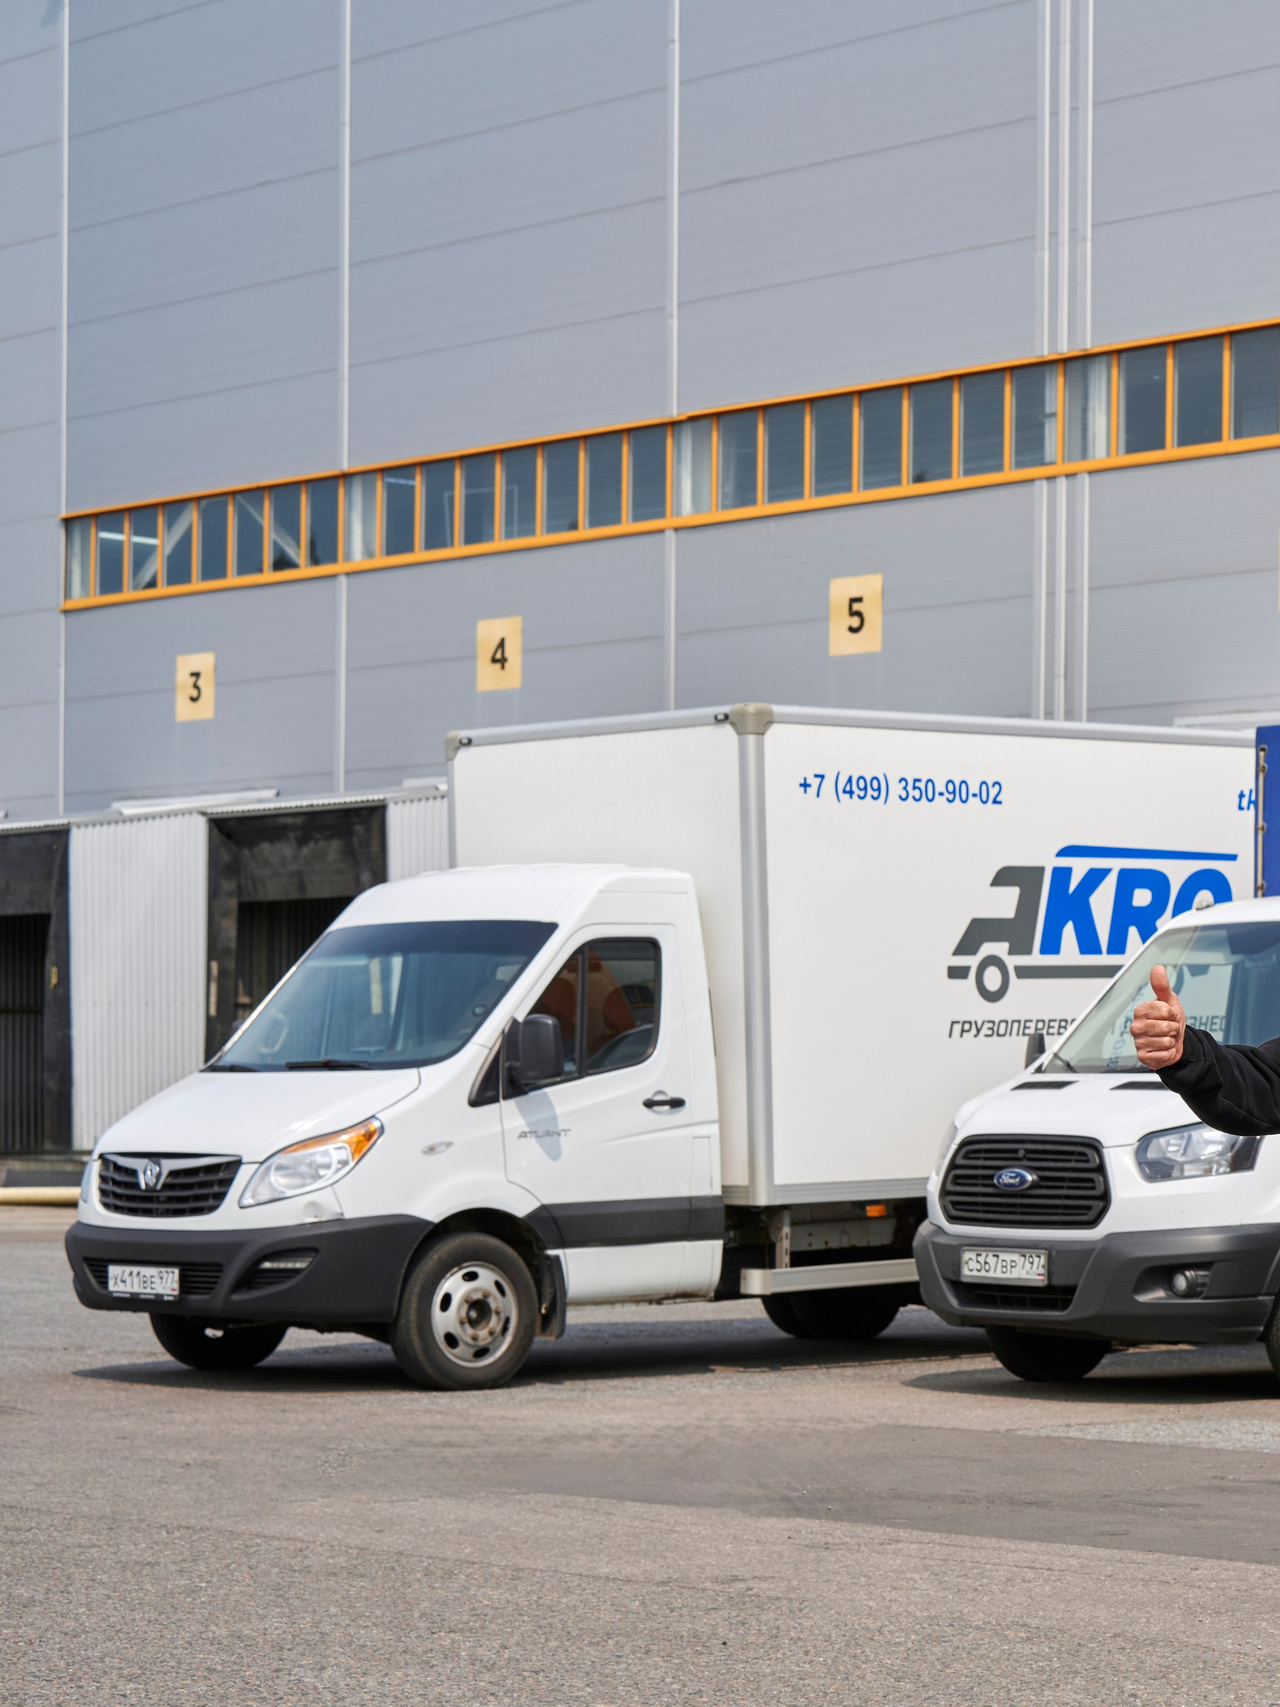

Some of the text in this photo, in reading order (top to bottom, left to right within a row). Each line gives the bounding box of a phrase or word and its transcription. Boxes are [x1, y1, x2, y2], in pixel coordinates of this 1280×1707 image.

[847, 596, 865, 634] 5
[490, 637, 508, 671] 4
[189, 671, 202, 703] 3
[799, 771, 1003, 805] +7 (499) 350-90-02
[948, 1018, 1077, 1038] ГРУЗОПЕРЕВ
[1020, 1254, 1042, 1270] 797
